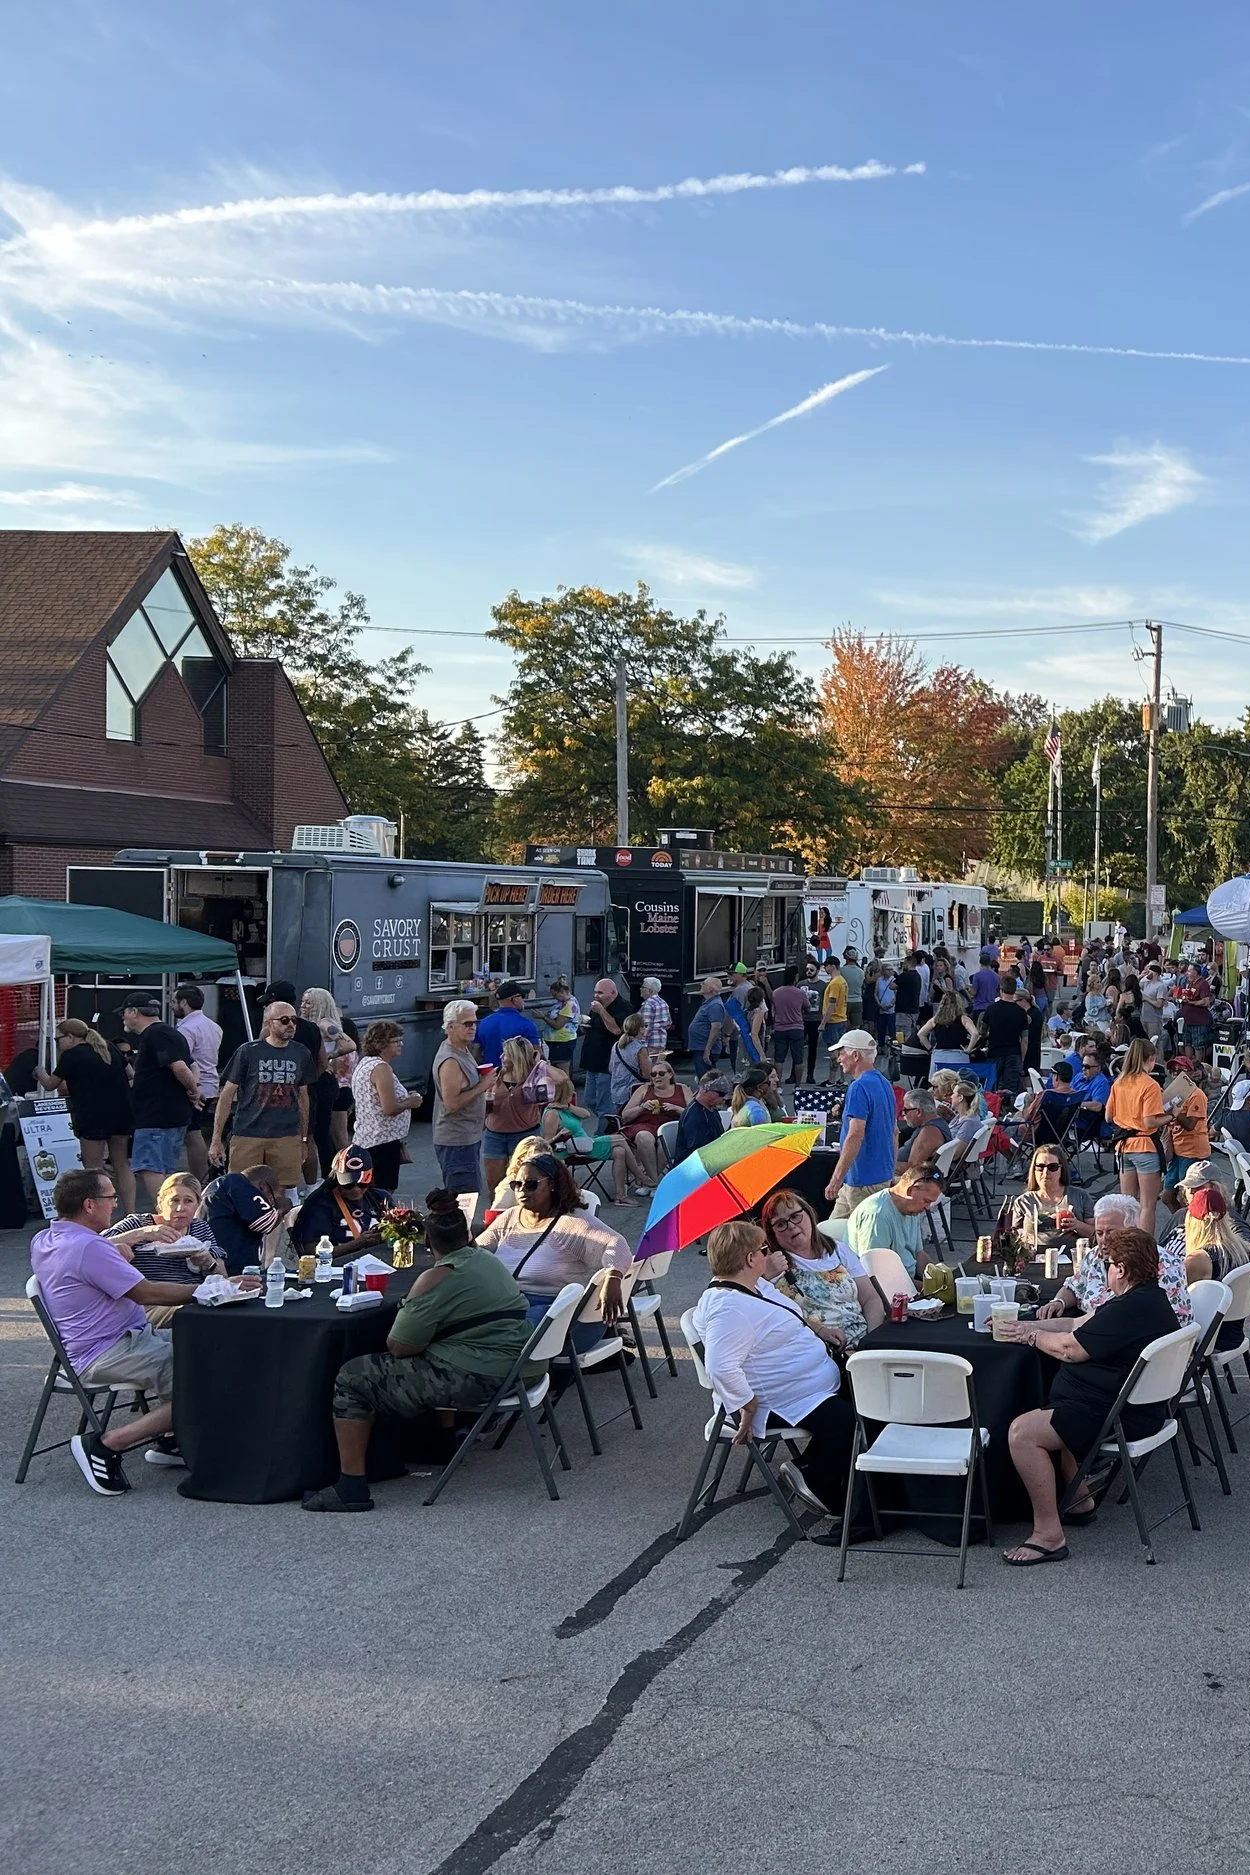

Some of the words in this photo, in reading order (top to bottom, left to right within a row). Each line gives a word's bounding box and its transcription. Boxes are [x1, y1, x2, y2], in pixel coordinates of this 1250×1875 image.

[576, 848, 597, 857] SHARK
[616, 853, 632, 862] food
[577, 856, 597, 866] TANK
[635, 901, 680, 912] Cousins
[646, 912, 680, 923] Maine
[373, 918, 422, 938] SAVORY
[640, 922, 679, 934] Lobster
[372, 938, 421, 957] CRUST
[258, 1059, 297, 1072] MUD
[258, 1071, 297, 1084] DER
[23, 1124, 53, 1136] ULTRA
